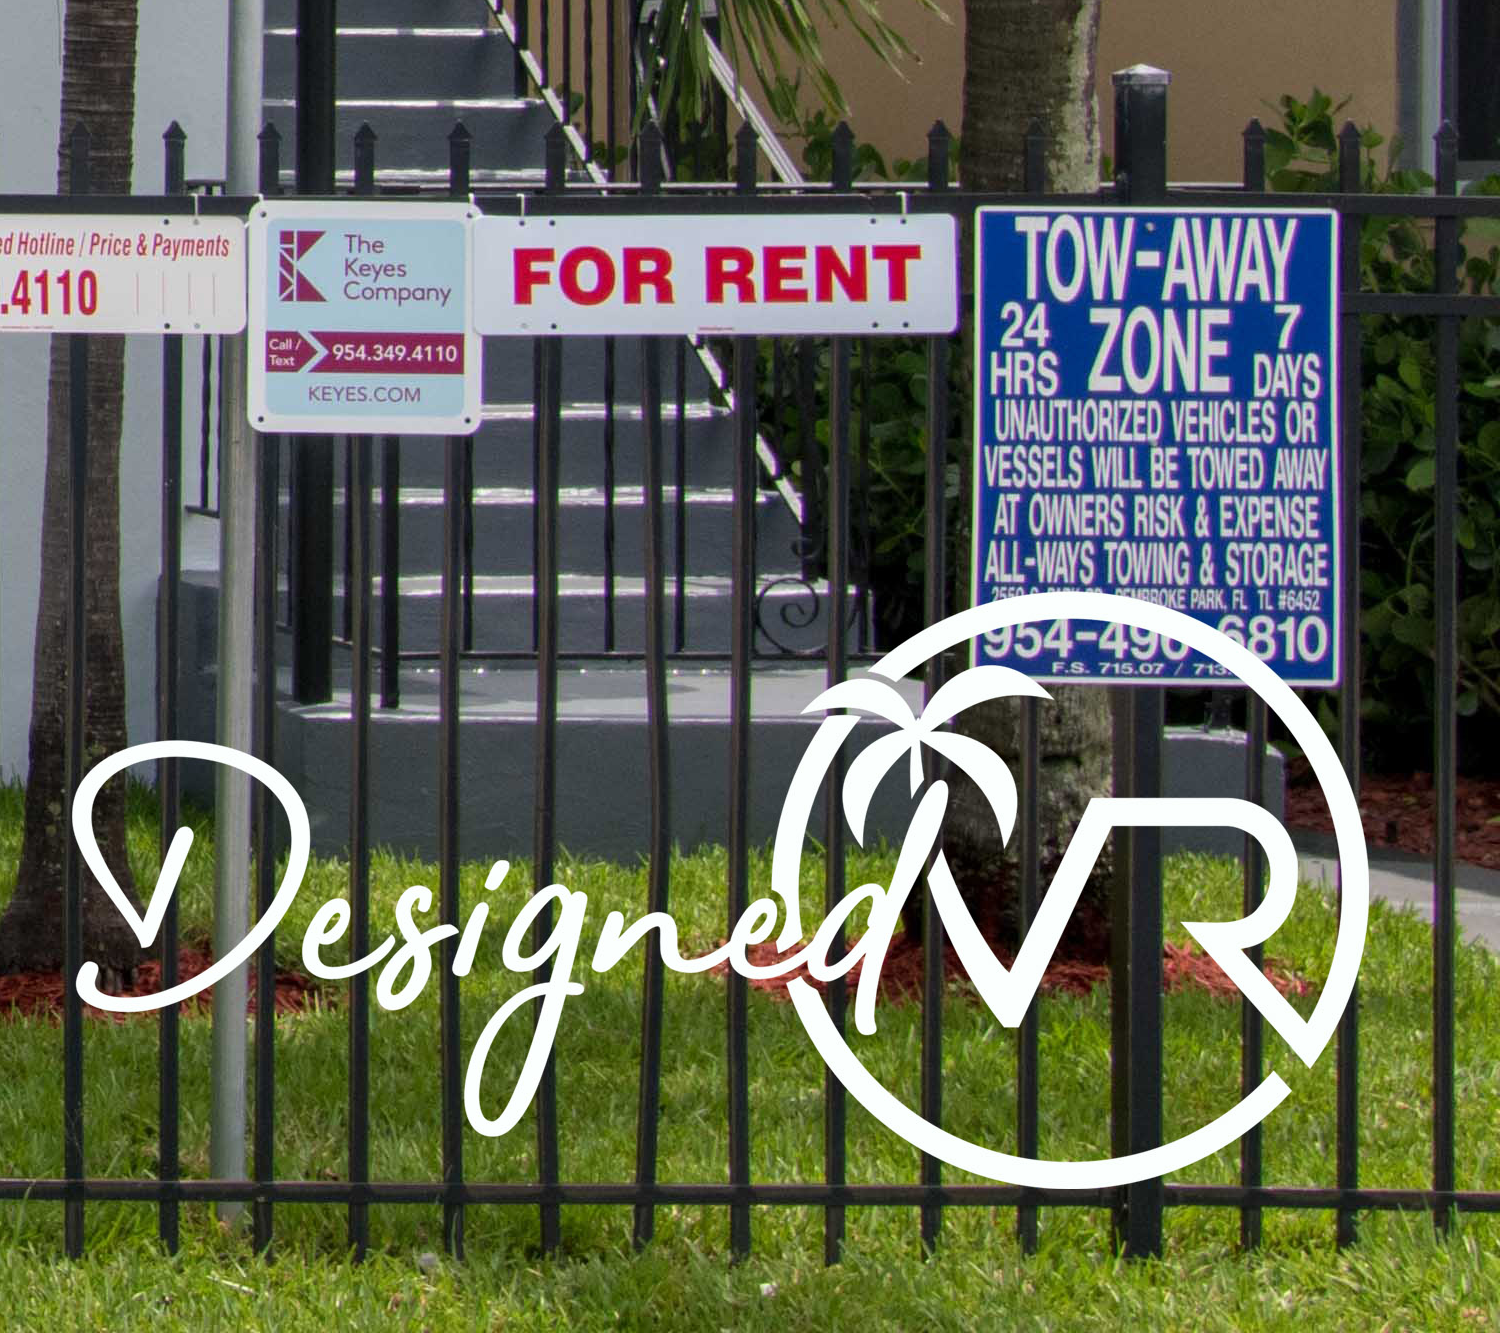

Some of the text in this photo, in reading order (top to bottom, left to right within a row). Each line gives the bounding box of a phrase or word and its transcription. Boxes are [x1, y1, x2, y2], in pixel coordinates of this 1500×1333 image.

[18, 232, 74, 255] Hotline
[89, 233, 131, 256] Price
[137, 233, 147, 256] &
[152, 233, 229, 260] Payments
[344, 234, 384, 253] The
[1014, 214, 1298, 303] TOW-AWAY
[345, 258, 406, 282] Keyes
[514, 245, 921, 305] FOR RENT
[344, 280, 451, 307] Company
[269, 338, 292, 350] Call
[1001, 302, 1051, 347] 24
[1275, 304, 1302, 349] 7
[269, 355, 294, 366] Text
[333, 344, 457, 362] 954.349.4110
[1089, 306, 1231, 394] ZONE
[309, 386, 420, 402] KEYES.COM
[991, 351, 1059, 397] HRS
[1255, 354, 1321, 399] DAYS
[996, 399, 1317, 444] UNAUTHORIZED VEHICLES OR
[985, 445, 1328, 490] VESSELS WILL BE TOWED AWAY
[994, 493, 1320, 538] AT OWNERS RISK & EXPENSE
[985, 541, 1328, 587] ALL-WAYS TOWING & STORAGE
[1190, 589, 1228, 613] PARK,
[1232, 590, 1248, 611] FL
[1257, 590, 1273, 611] TL
[1278, 590, 1321, 611] #6452
[1051, 662, 1090, 674] F.S.
[1098, 662, 1165, 675] 715.07
